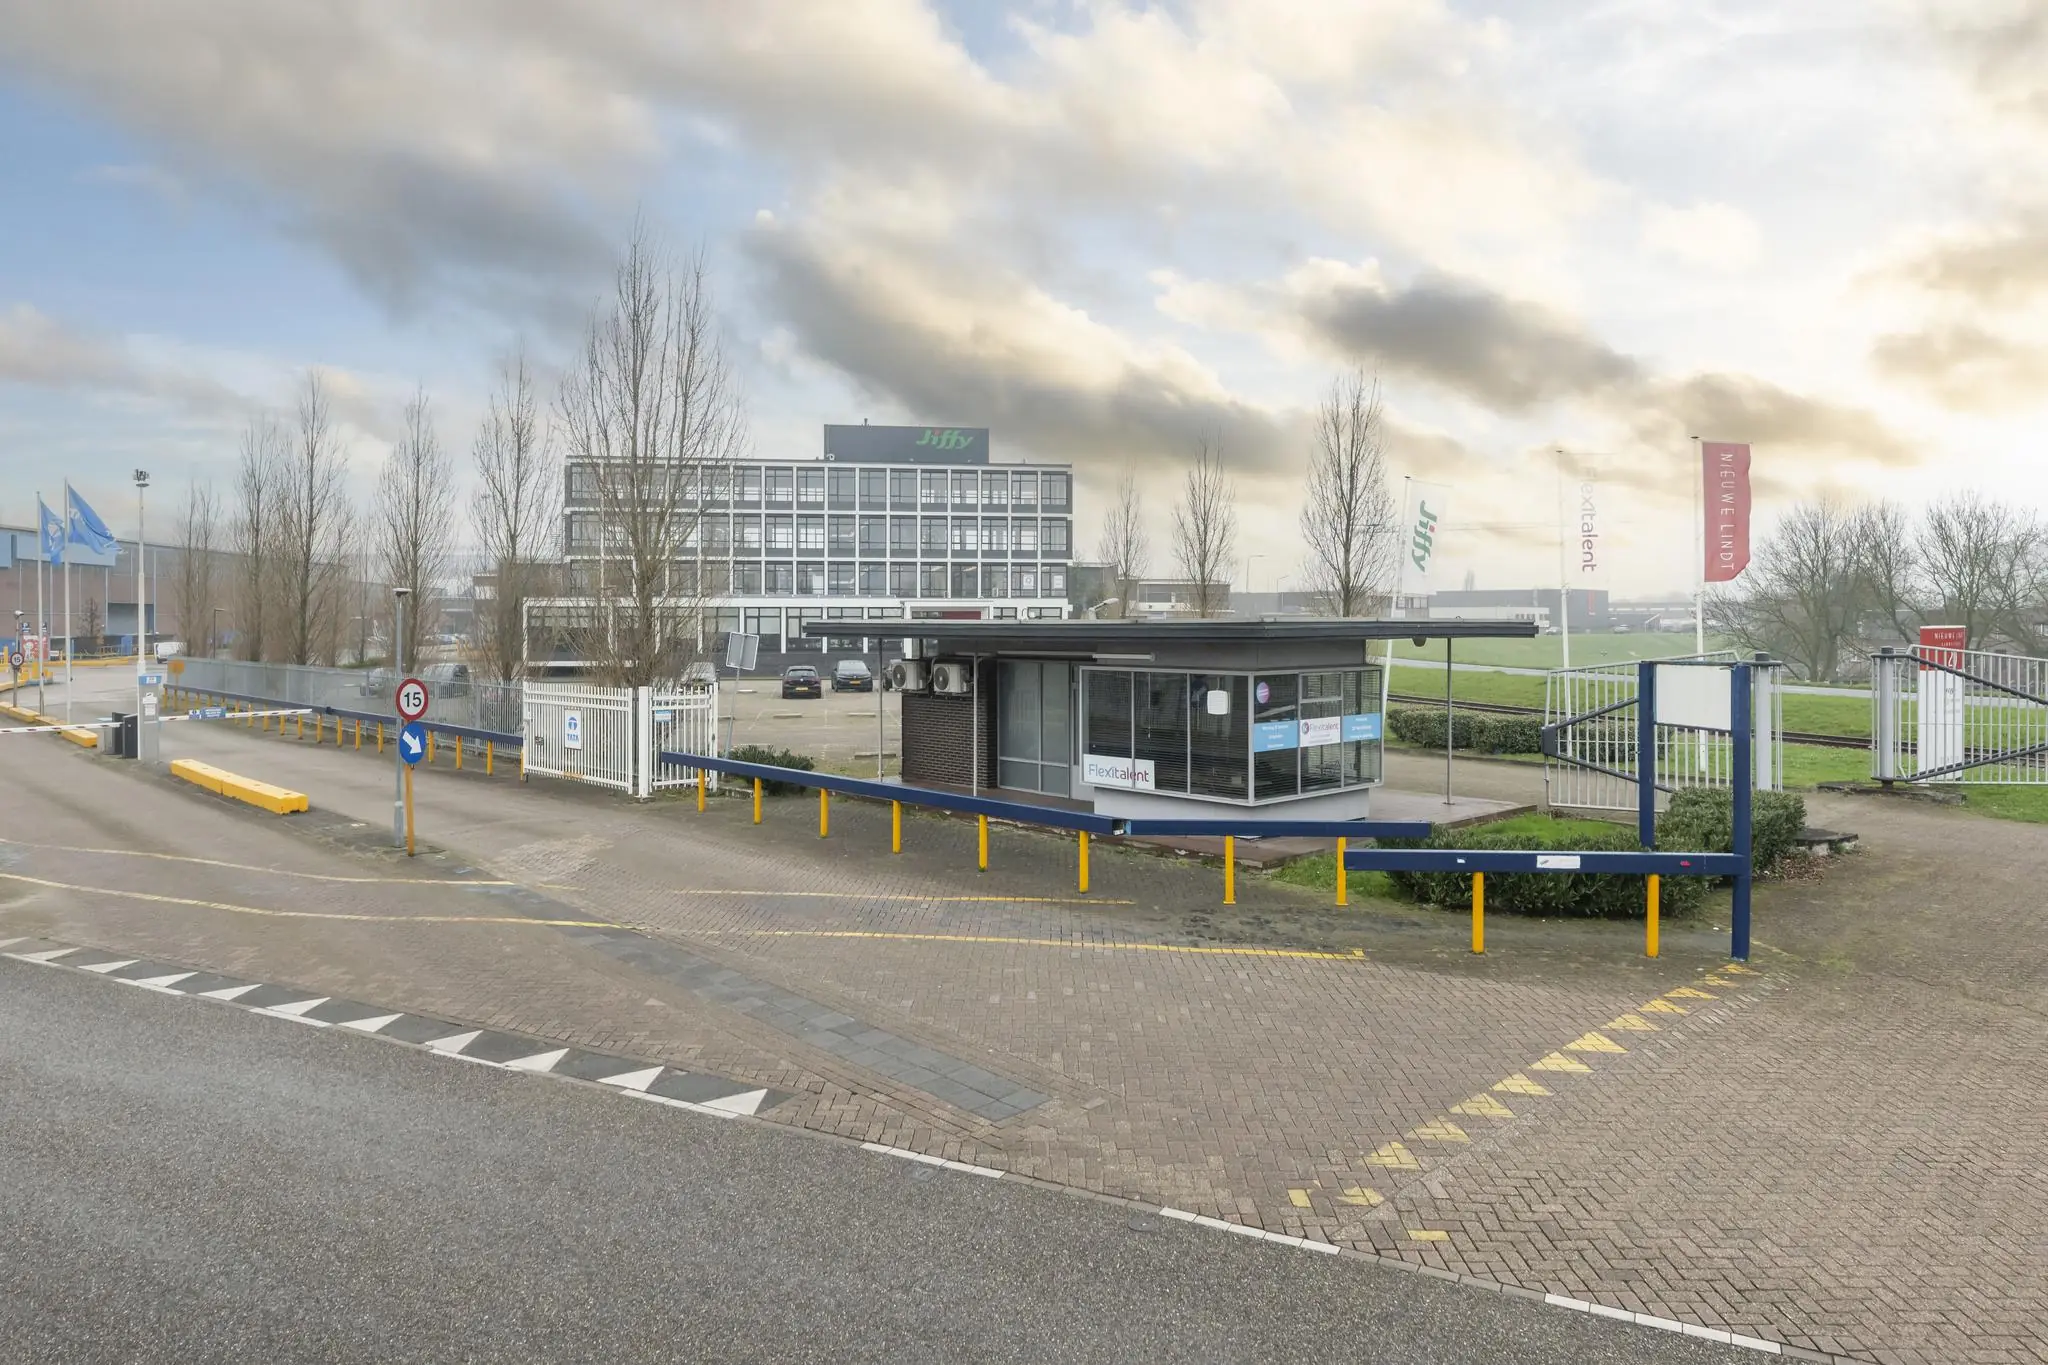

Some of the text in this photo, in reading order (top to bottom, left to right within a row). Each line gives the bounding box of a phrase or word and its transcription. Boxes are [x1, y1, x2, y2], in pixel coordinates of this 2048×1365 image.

[915, 428, 974, 450] Jiffy
[1720, 453, 1736, 570] NIEUWE LINDT
[1411, 499, 1438, 573] Jiffy
[404, 692, 422, 708] 15
[1088, 763, 1150, 783] Flexitalent
